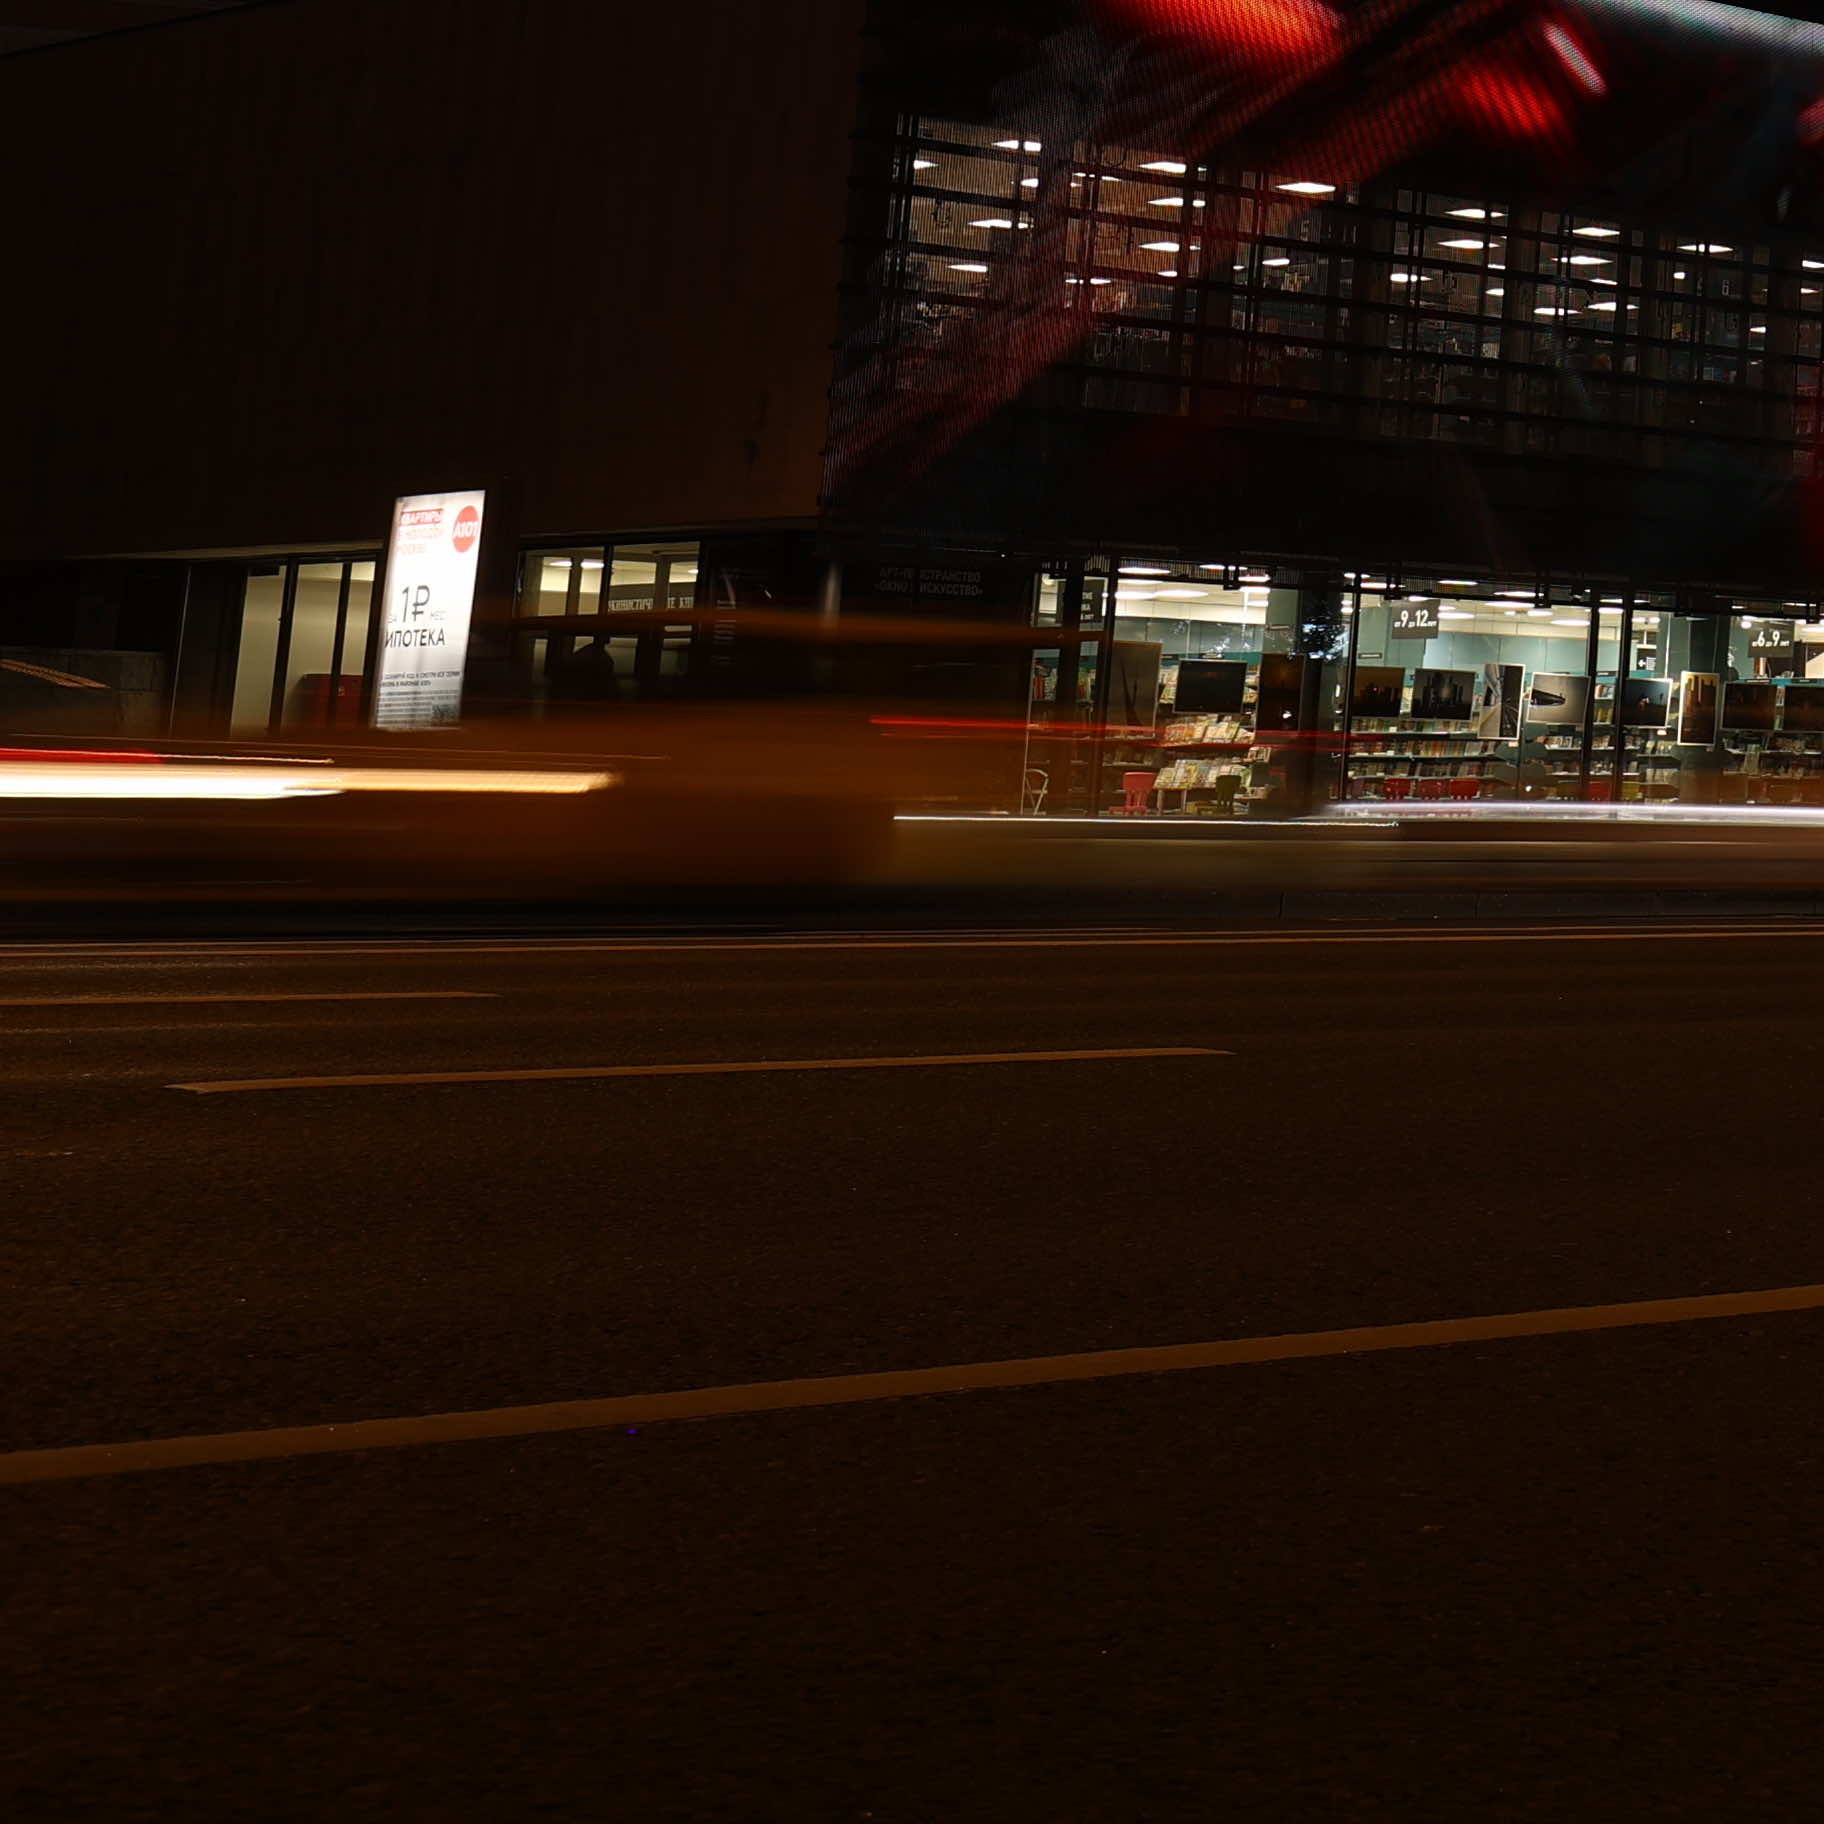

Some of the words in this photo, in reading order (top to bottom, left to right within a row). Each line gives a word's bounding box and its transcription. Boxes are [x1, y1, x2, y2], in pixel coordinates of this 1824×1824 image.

[402, 585, 430, 622] 1₽
[1401, 610, 1409, 628] 9
[1415, 609, 1429, 627] 12
[385, 628, 446, 648] ИПОТЕКА
[1758, 631, 1765, 647] 6
[1772, 631, 1780, 647] 9
